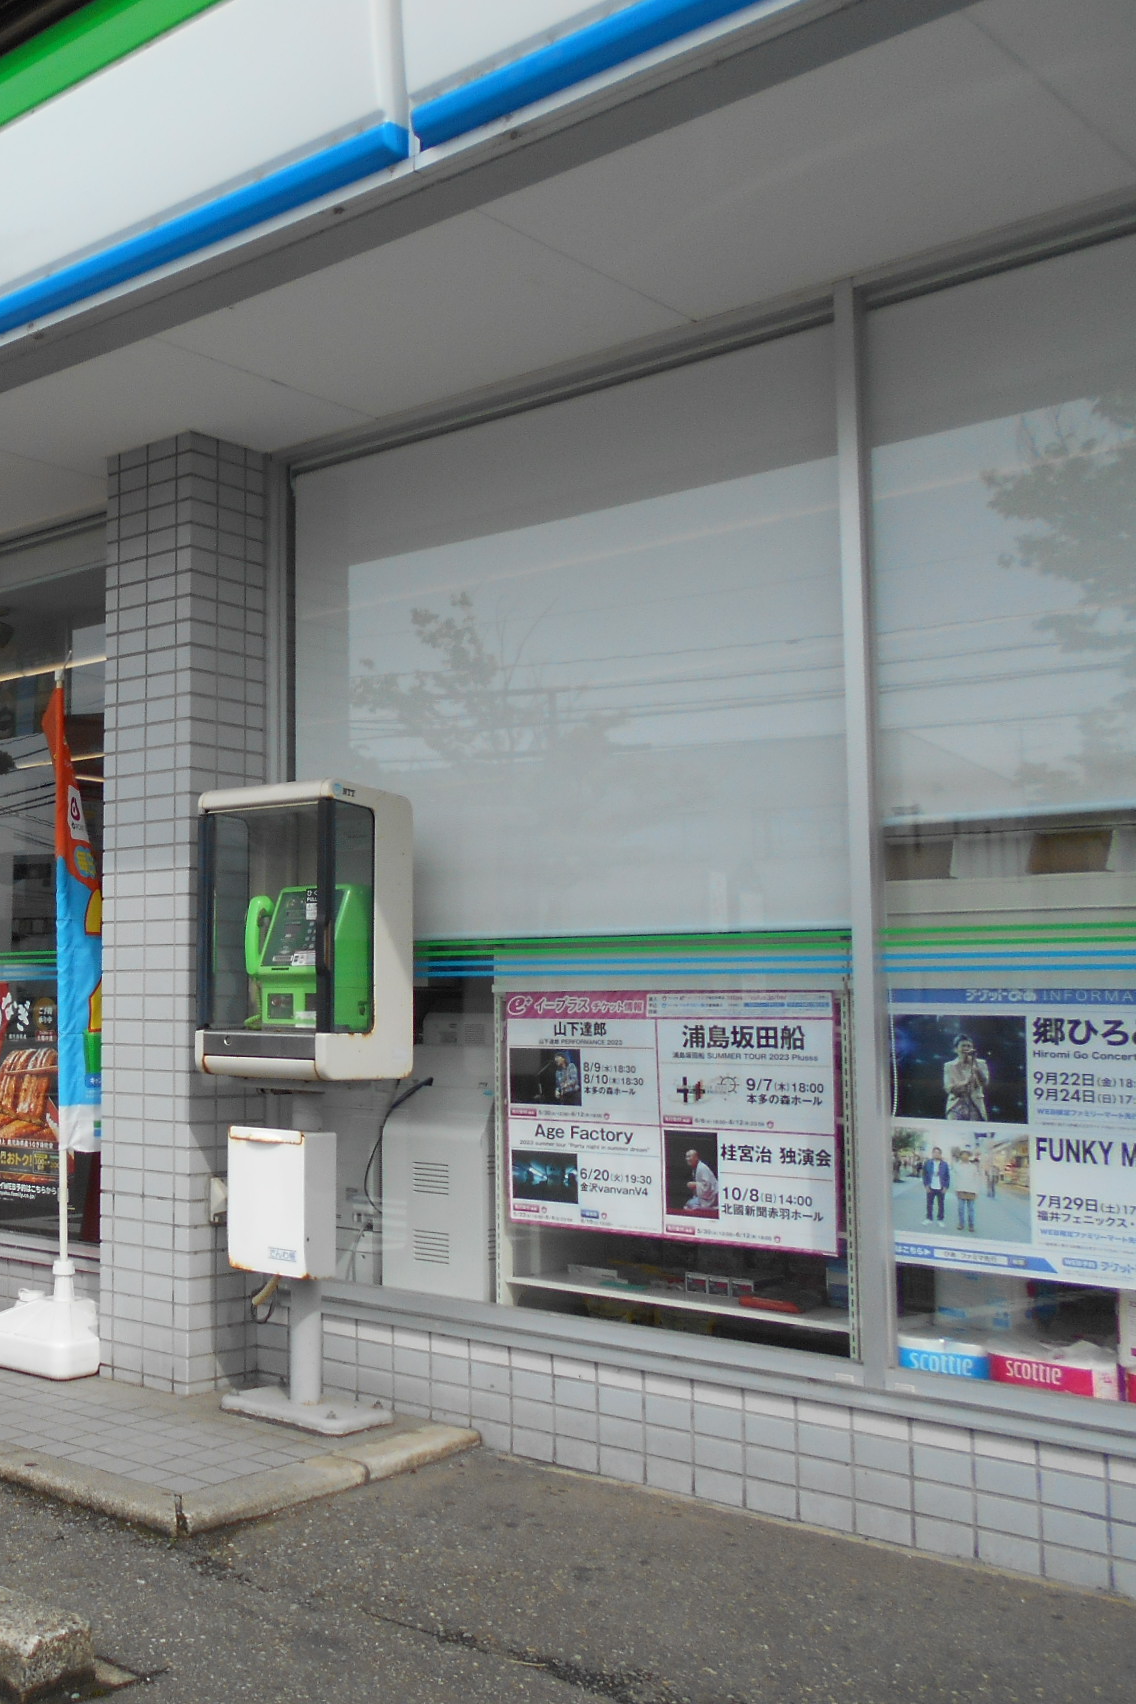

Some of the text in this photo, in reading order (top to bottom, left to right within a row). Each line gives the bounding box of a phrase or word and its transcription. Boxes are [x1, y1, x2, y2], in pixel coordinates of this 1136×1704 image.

[534, 996, 590, 1013] イープラス
[554, 1021, 607, 1036] 山下達郎
[682, 1025, 806, 1050] 浦島坂田船
[1032, 1016, 1136, 1046] 郷ひろ
[744, 1053, 767, 1061] TOUR
[1032, 1050, 1070, 1060] Hiromi
[1073, 1051, 1089, 1060] Go
[583, 1086, 636, 1096] 本多の森ホール
[746, 1094, 823, 1107] 本多の森ホール
[534, 1123, 634, 1144] Age Factory
[720, 1143, 832, 1168] 桂宮治 独演会
[1035, 1136, 1113, 1166] FUNKY
[580, 1182, 649, 1196] 金沢vanvanV4
[721, 1204, 824, 1222] 北國新聞赤羽ホール
[909, 1352, 973, 1376] scottie
[1006, 1361, 1062, 1385] scottie
